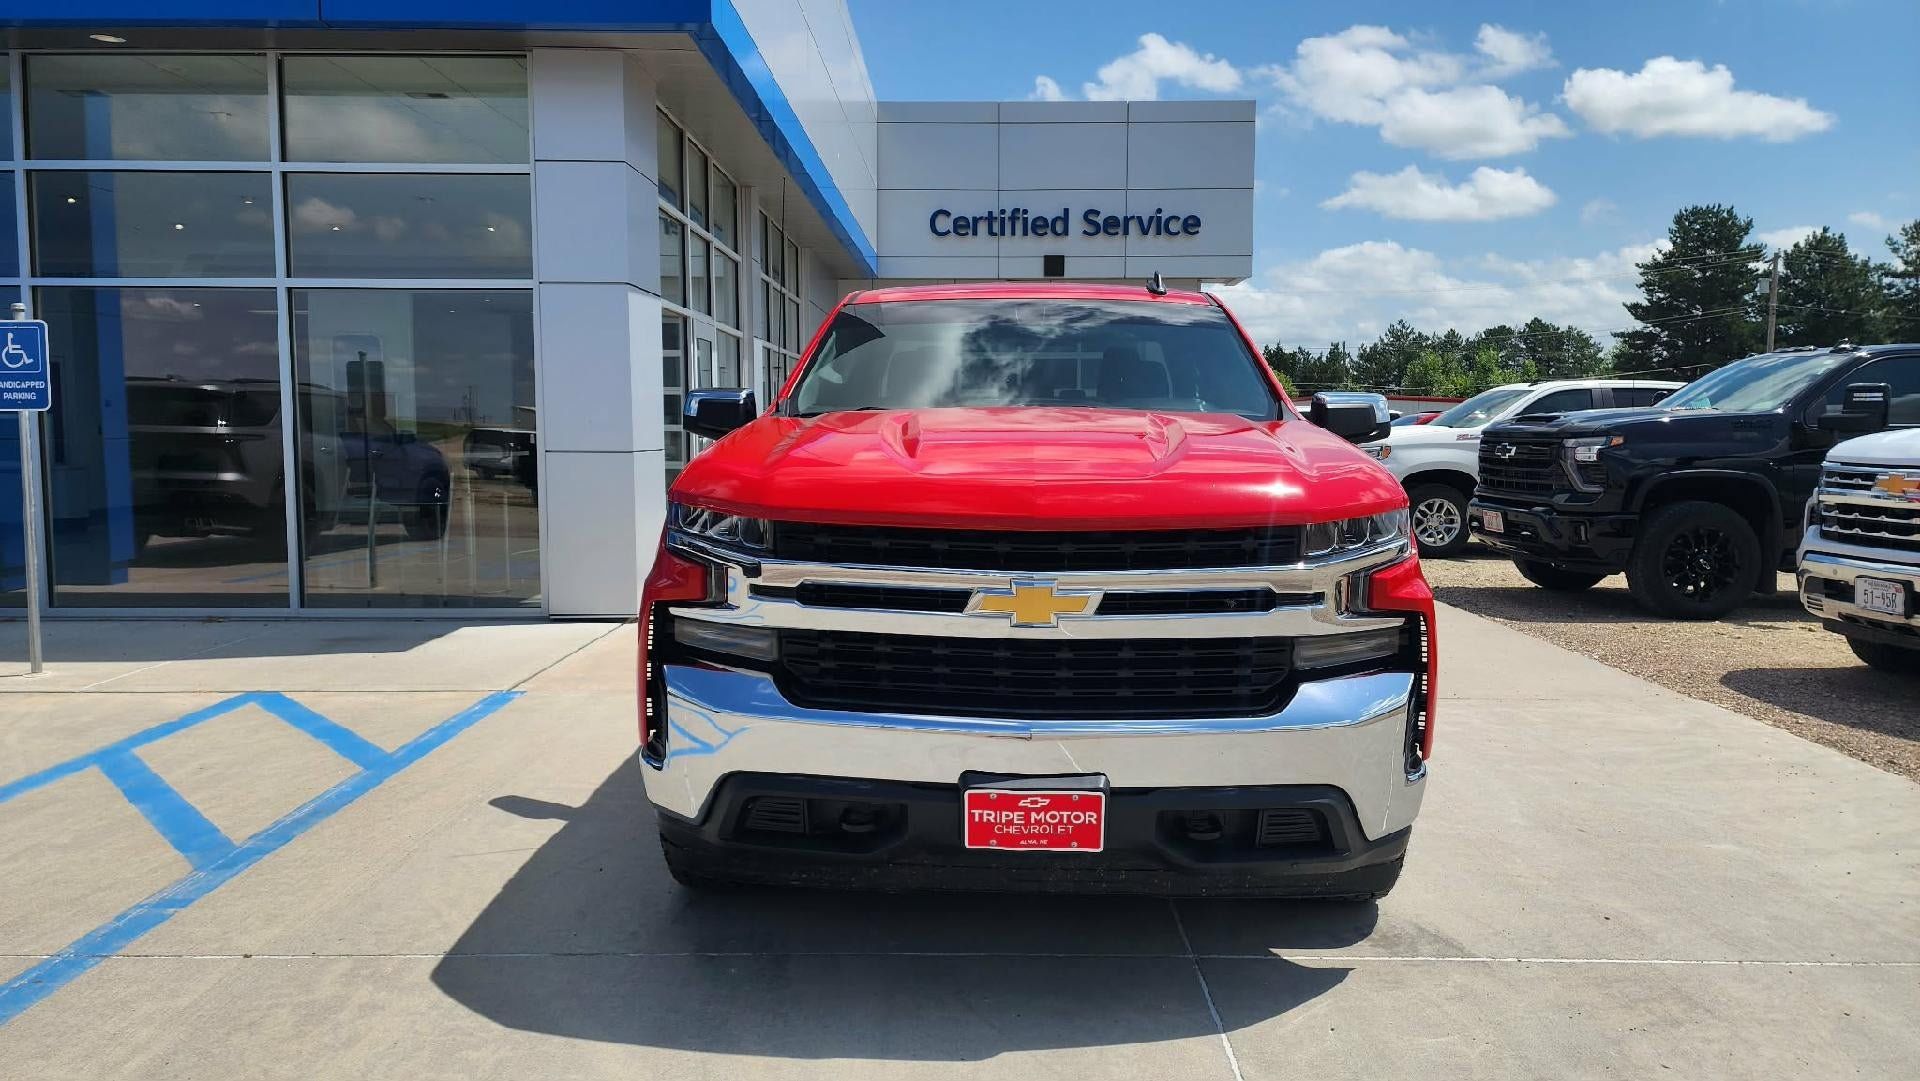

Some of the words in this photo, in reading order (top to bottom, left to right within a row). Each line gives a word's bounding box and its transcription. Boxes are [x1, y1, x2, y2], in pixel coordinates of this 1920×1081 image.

[929, 207, 1070, 237] Certified
[1082, 207, 1202, 236] Service
[3, 391, 37, 400] PARKING
[971, 809, 1025, 824] TRIPE
[1031, 811, 1097, 825] MOTOR
[994, 824, 1074, 835] CHEVROLET
